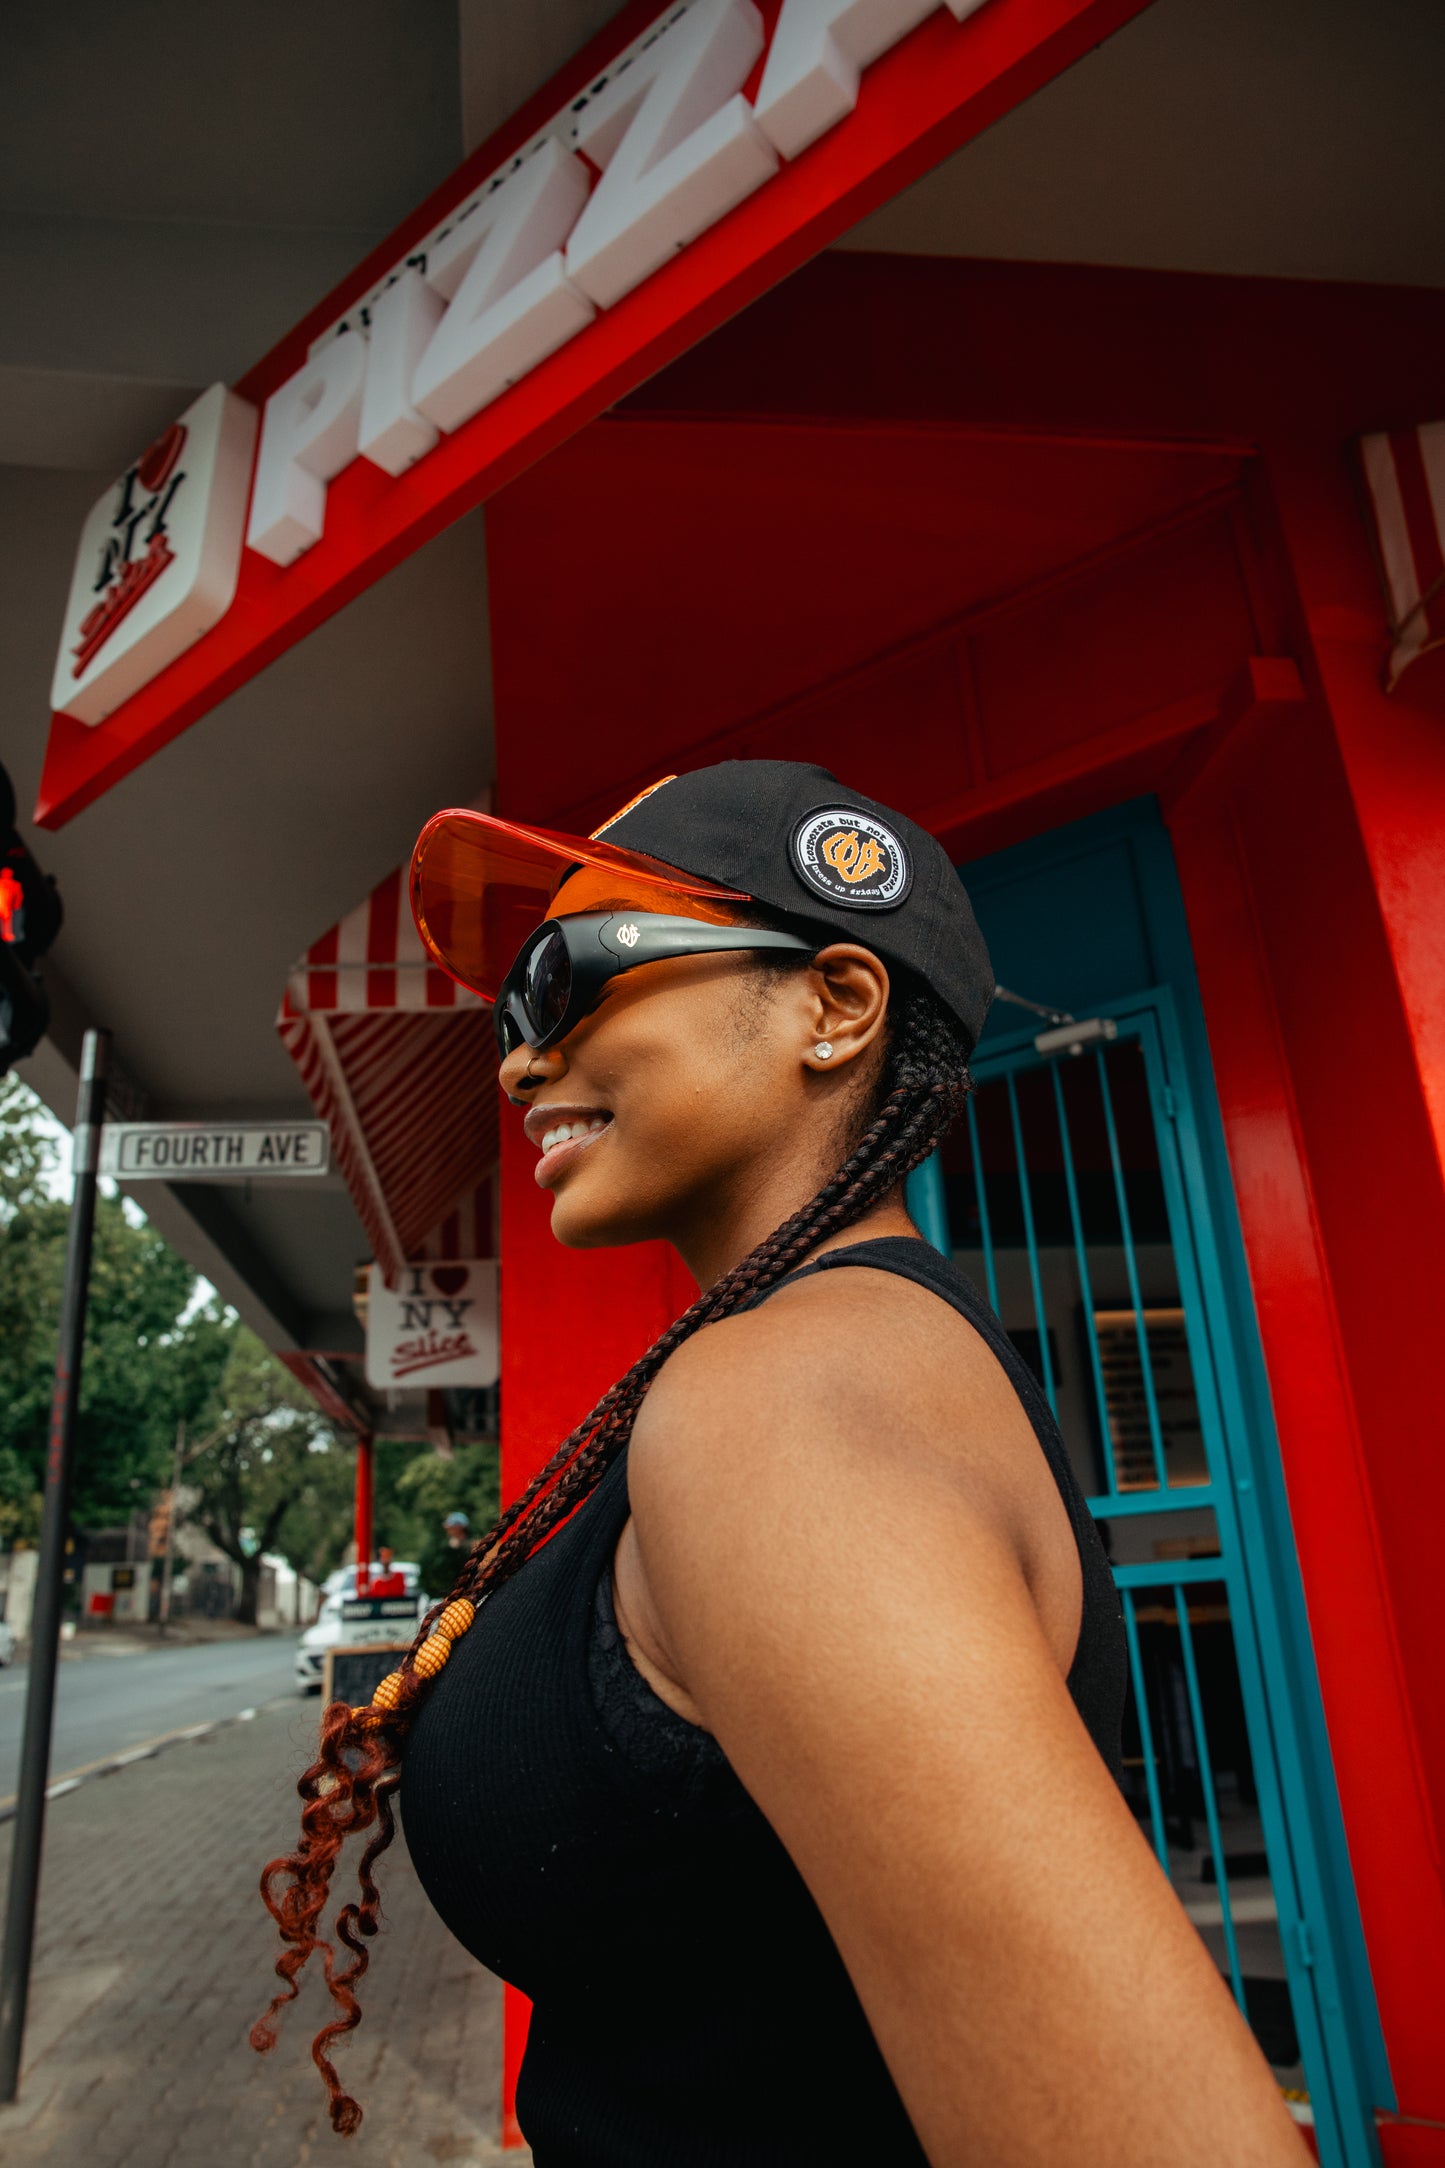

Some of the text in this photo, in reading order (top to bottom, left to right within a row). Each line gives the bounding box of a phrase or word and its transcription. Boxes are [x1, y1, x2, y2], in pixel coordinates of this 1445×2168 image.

[806, 819, 835, 862] corporate
[839, 818, 861, 828] but
[866, 825, 887, 841] not
[883, 844, 899, 892] corporate
[834, 884, 846, 893] up
[136, 1133, 309, 1165] FOURTH AVE
[409, 1267, 424, 1296] I
[398, 1300, 475, 1330] NY
